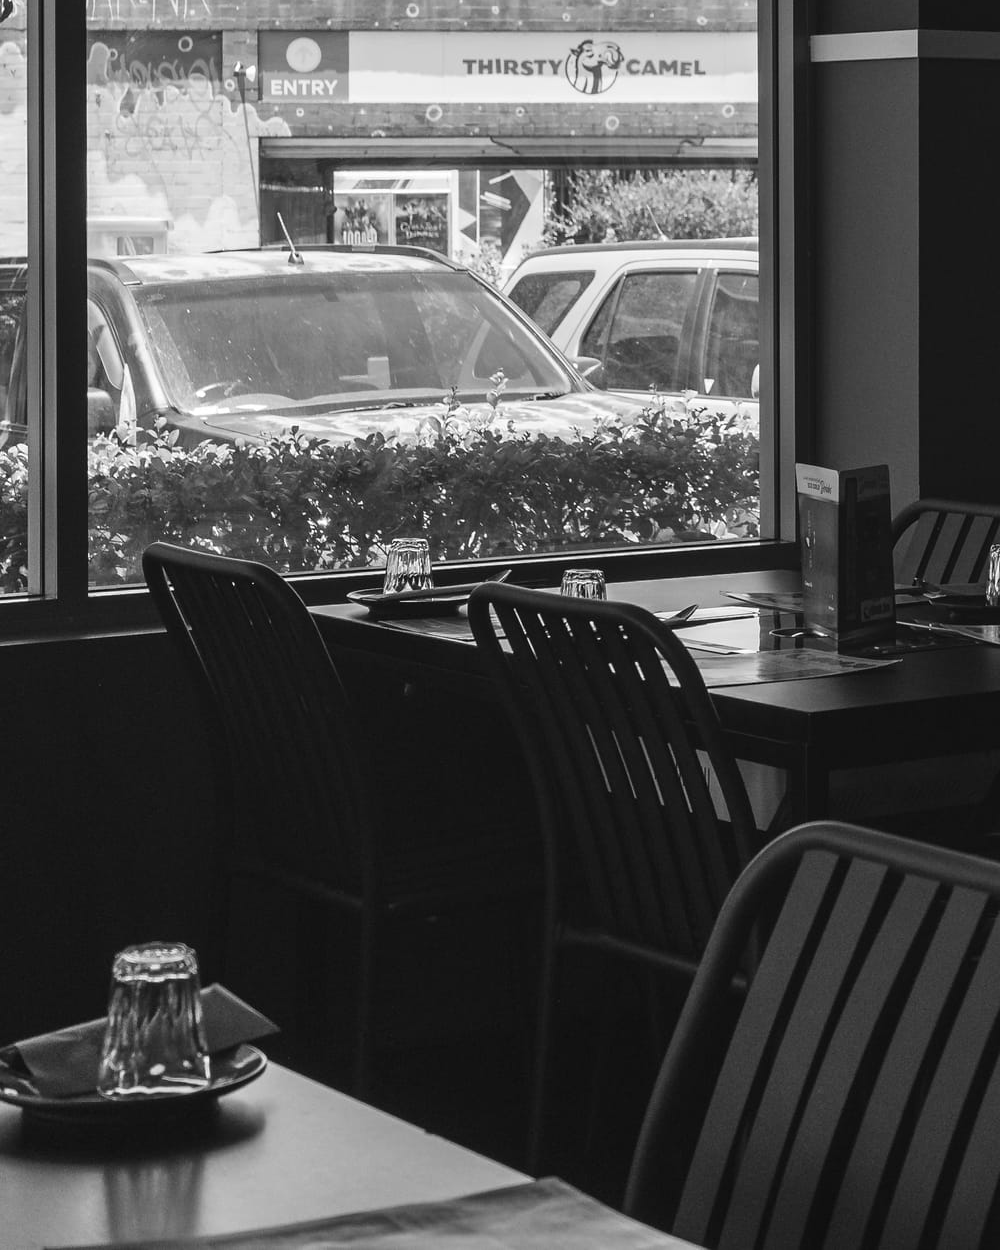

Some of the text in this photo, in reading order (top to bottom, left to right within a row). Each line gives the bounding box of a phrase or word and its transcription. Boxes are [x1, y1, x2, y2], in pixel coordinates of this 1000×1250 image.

[462, 57, 707, 77] THIRSTY CAMEL
[270, 78, 339, 97] ENTRY
